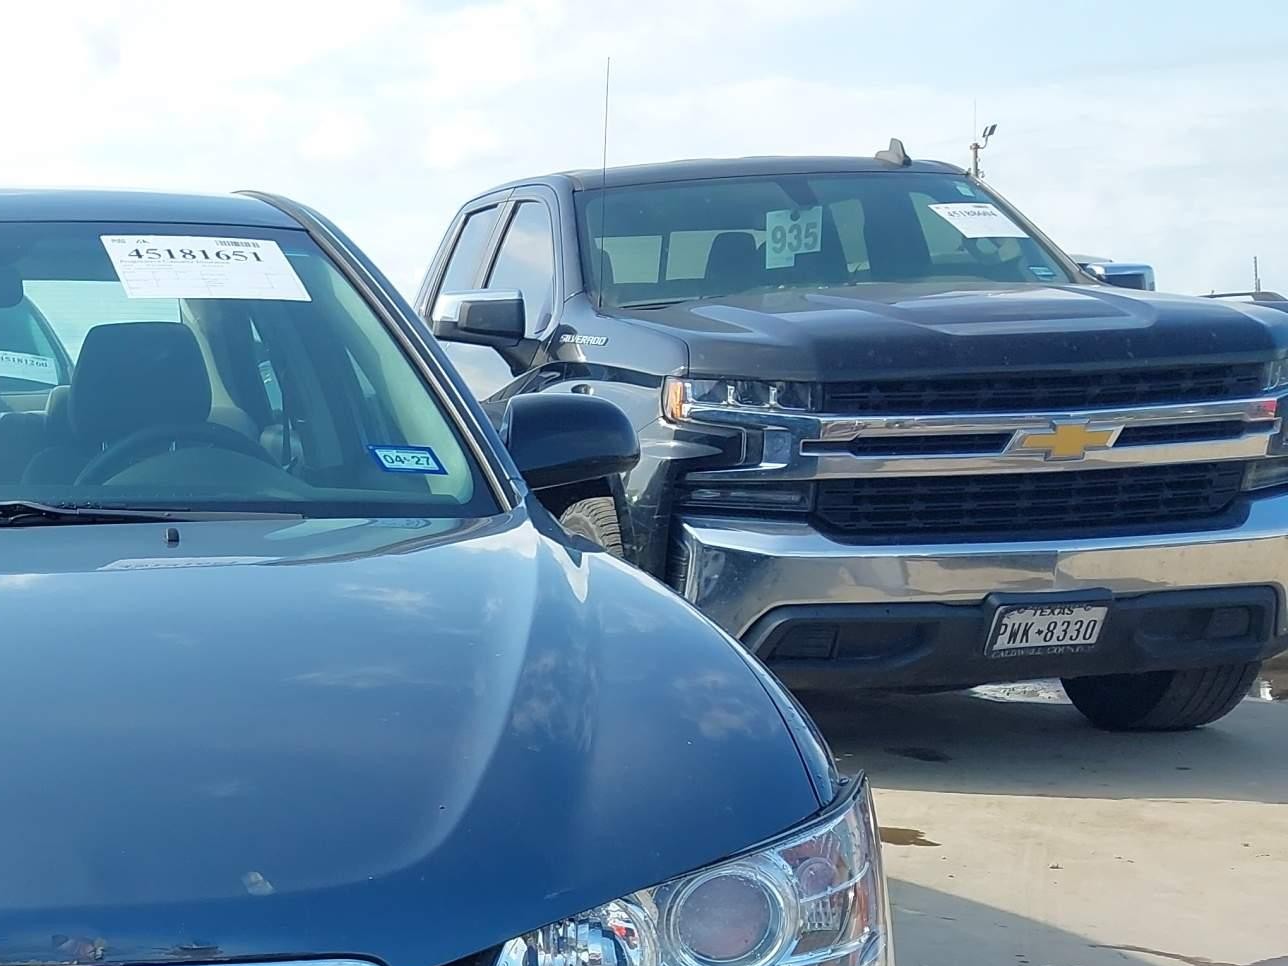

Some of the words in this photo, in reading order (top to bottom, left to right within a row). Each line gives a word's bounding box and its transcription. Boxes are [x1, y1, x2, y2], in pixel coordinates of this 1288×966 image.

[771, 222, 818, 254] 935
[128, 248, 264, 263] 45181651
[560, 334, 608, 346] SILVERADO
[1031, 606, 1074, 617] TEXAS
